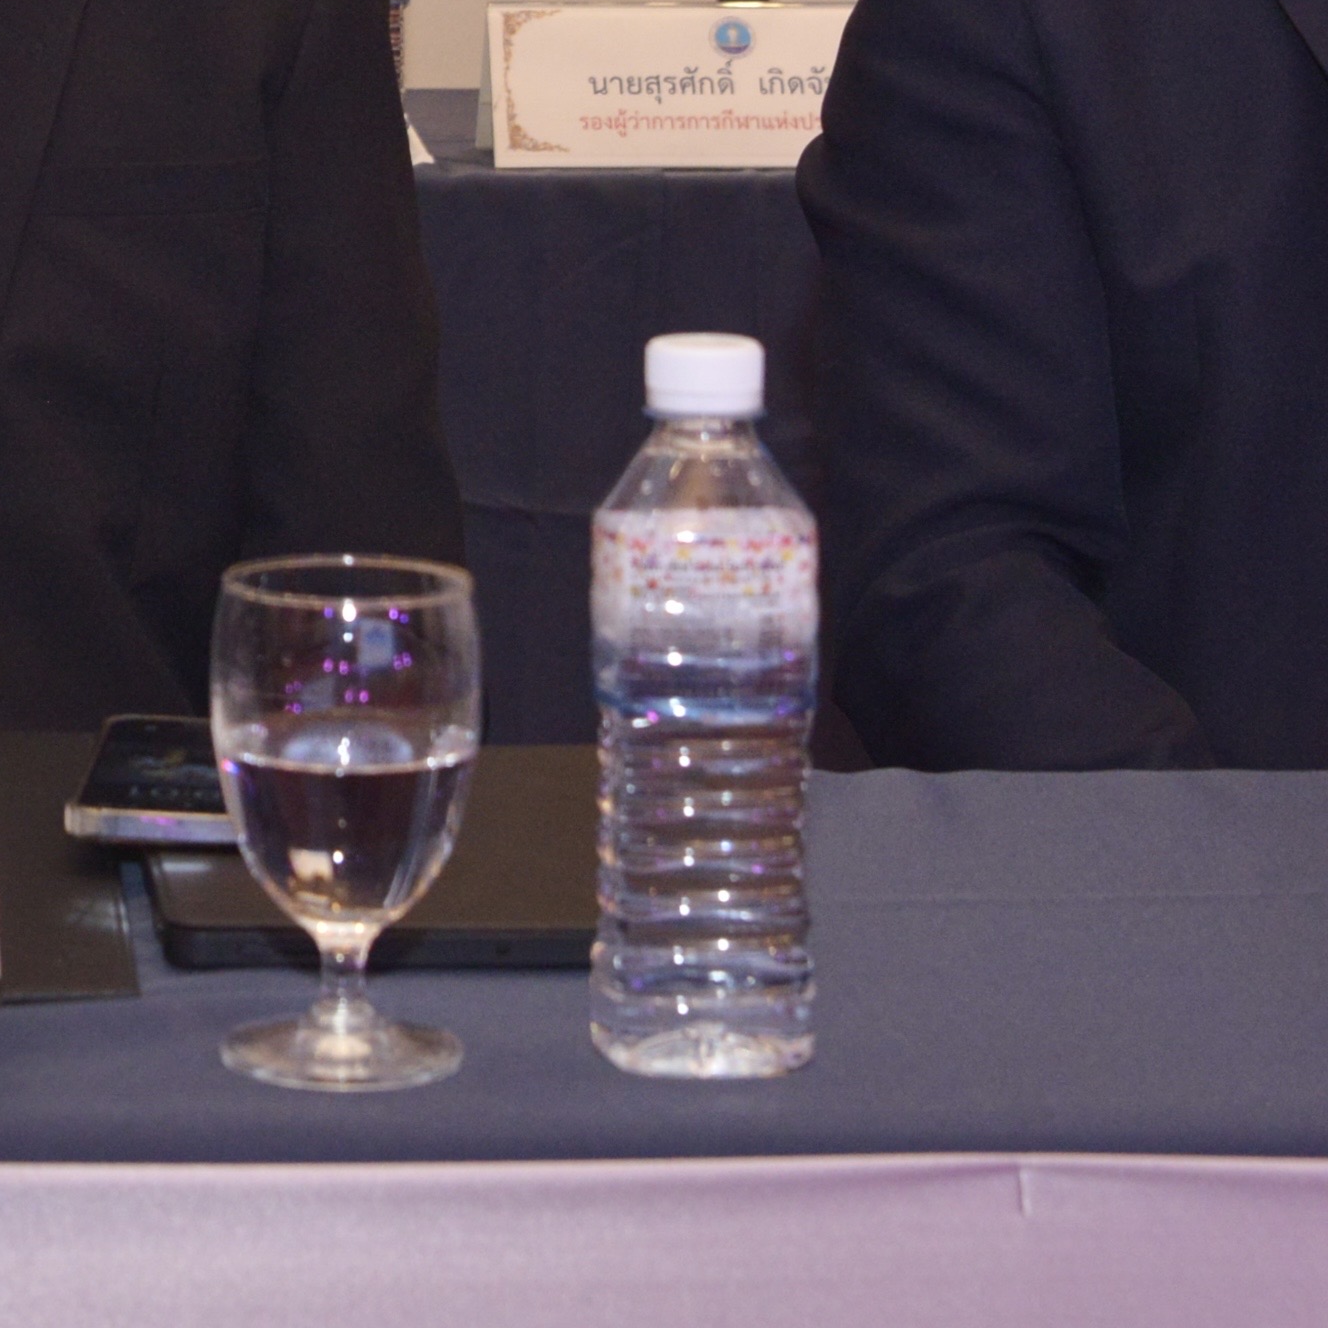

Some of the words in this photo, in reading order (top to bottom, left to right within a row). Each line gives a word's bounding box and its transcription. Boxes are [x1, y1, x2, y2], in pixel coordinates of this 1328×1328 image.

[587, 58, 735, 105] นายสุรศักดิ์
[758, 66, 831, 96] เกิดจั
